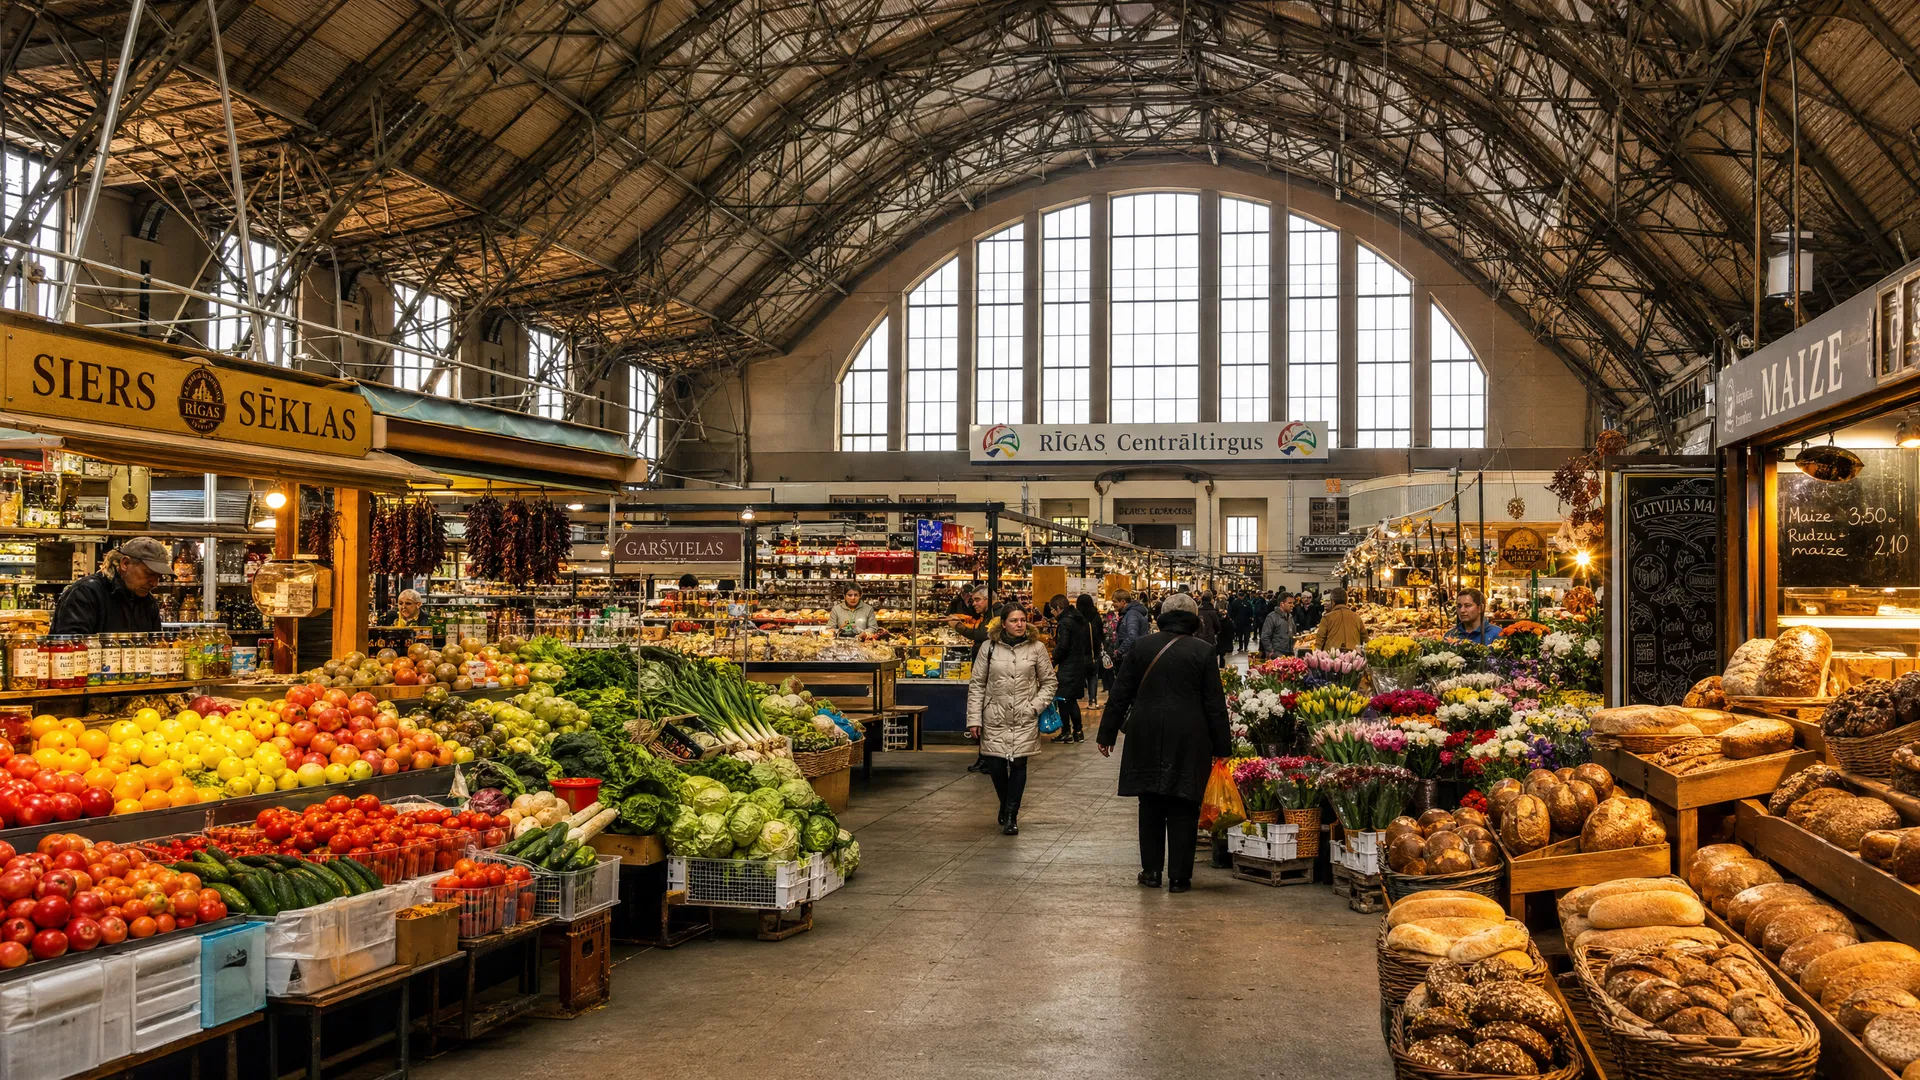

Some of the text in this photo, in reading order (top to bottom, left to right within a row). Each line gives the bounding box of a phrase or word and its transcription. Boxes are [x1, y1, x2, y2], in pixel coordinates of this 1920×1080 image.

[32, 353, 156, 412] SIERS
[1760, 329, 1843, 420] MAIZE
[239, 387, 356, 441] SĒKLAS
[1039, 431, 1263, 455] RĪGAS Centrāltirgus
[1634, 499, 1690, 519] LATVIJAS
[1788, 506, 1834, 523] Maize
[625, 539, 724, 556] GARŠVIELAS
[1791, 535, 1908, 557] maize 2,10
